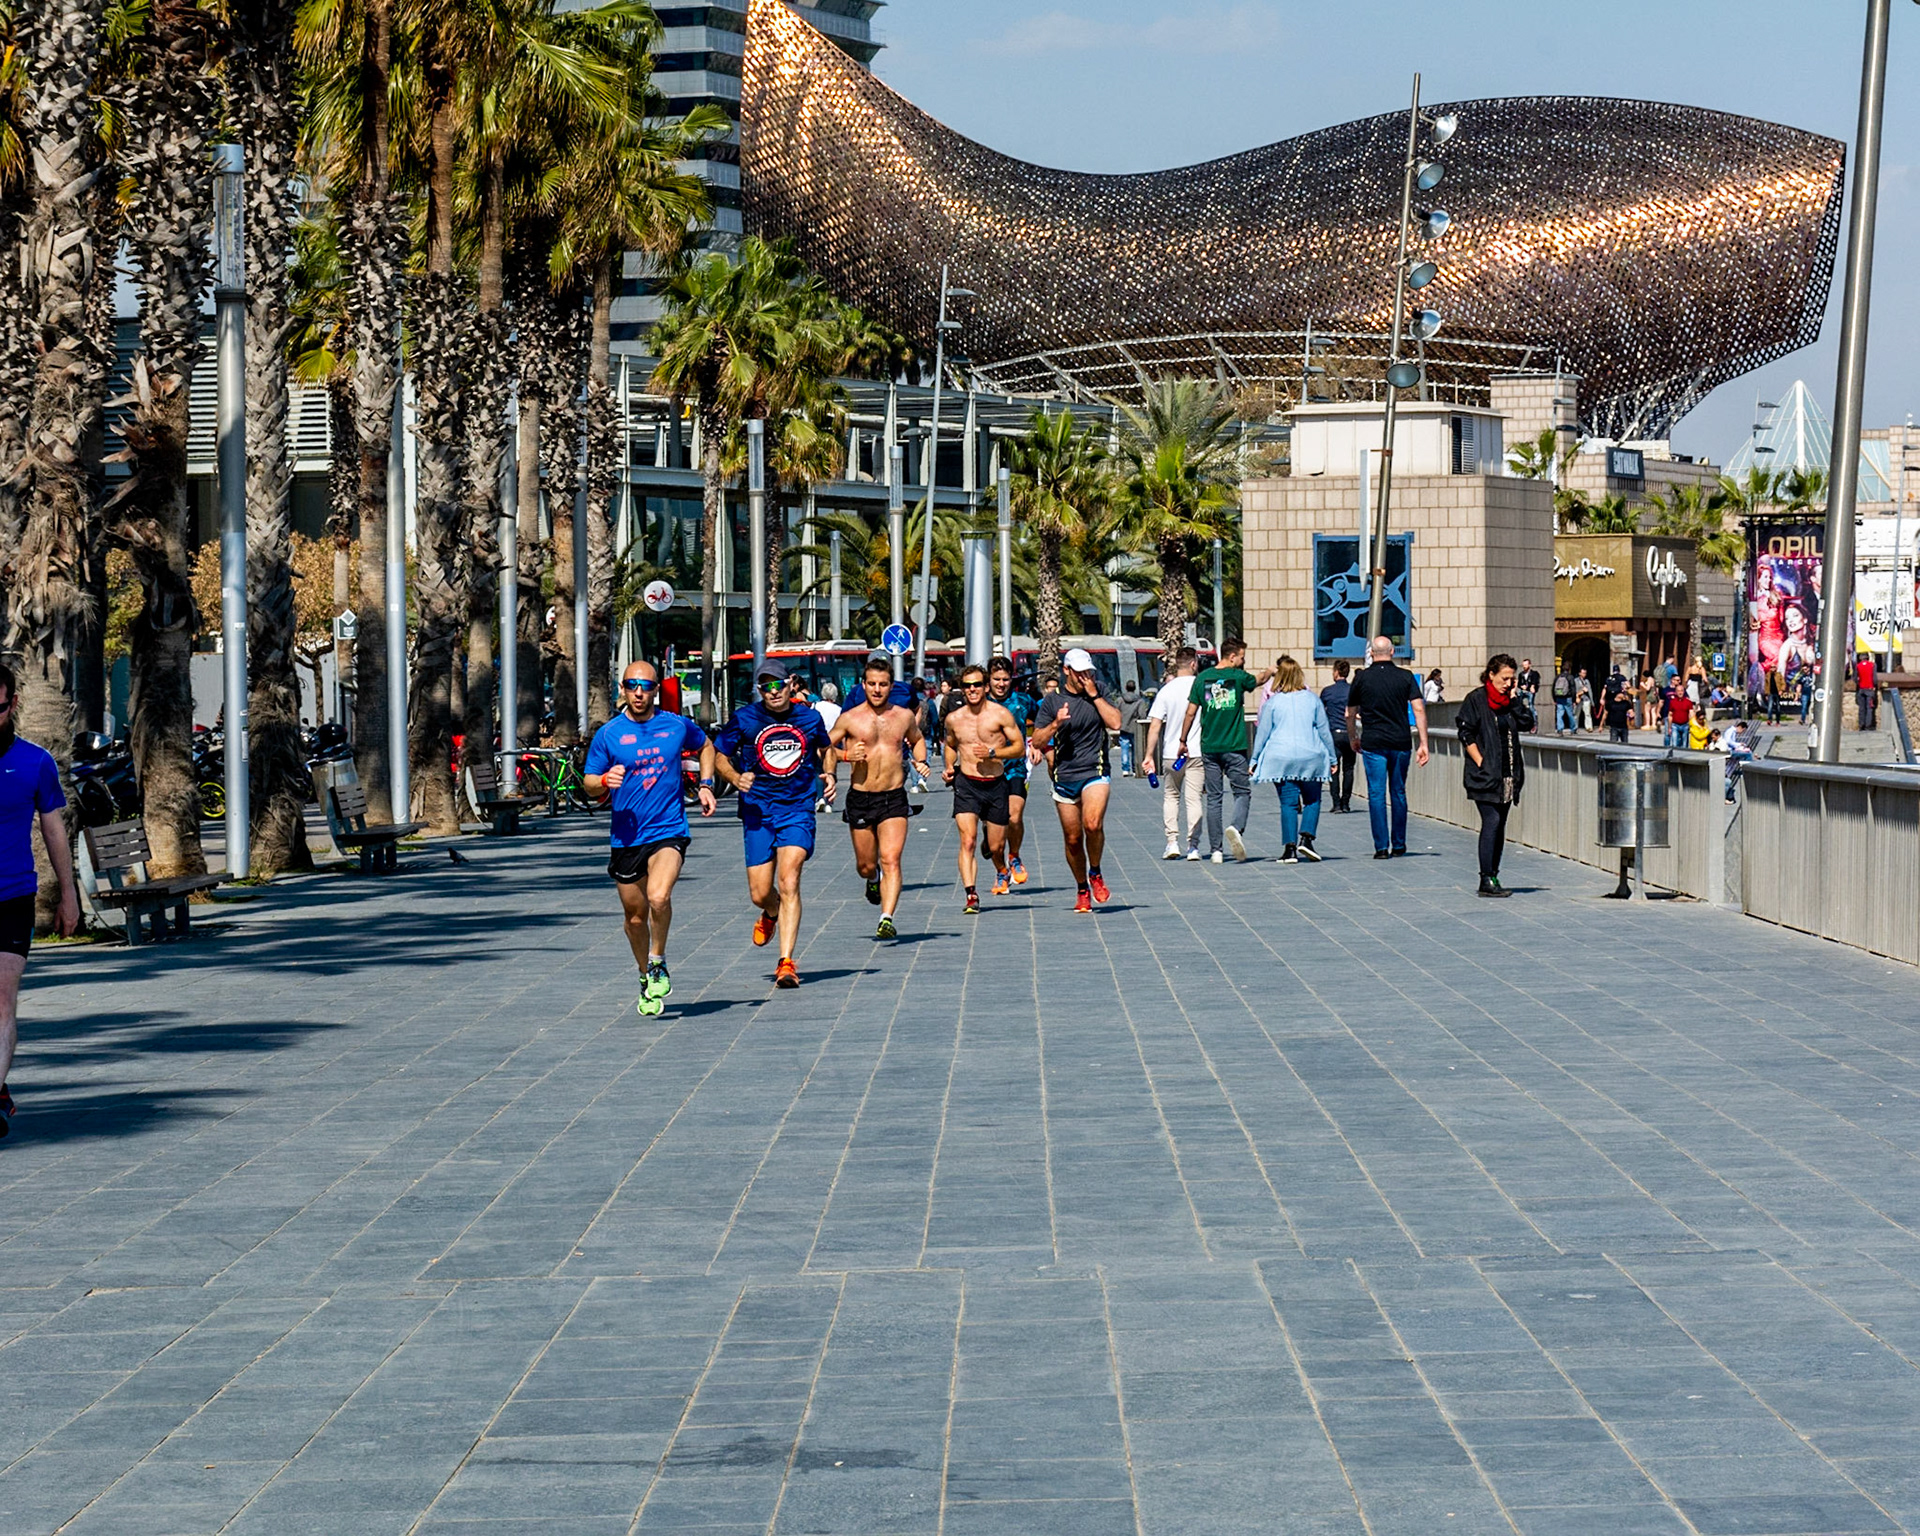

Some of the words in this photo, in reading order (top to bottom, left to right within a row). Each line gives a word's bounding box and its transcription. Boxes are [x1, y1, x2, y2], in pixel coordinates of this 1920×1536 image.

[1768, 535, 1823, 558] OPIU
[1769, 558, 1821, 566] BARCEL
[1859, 607, 1883, 621] ONE
[1884, 602, 1912, 619] NGHT
[1868, 619, 1911, 635] STAND
[1715, 655, 1723, 666] P
[637, 747, 660, 757] RUN
